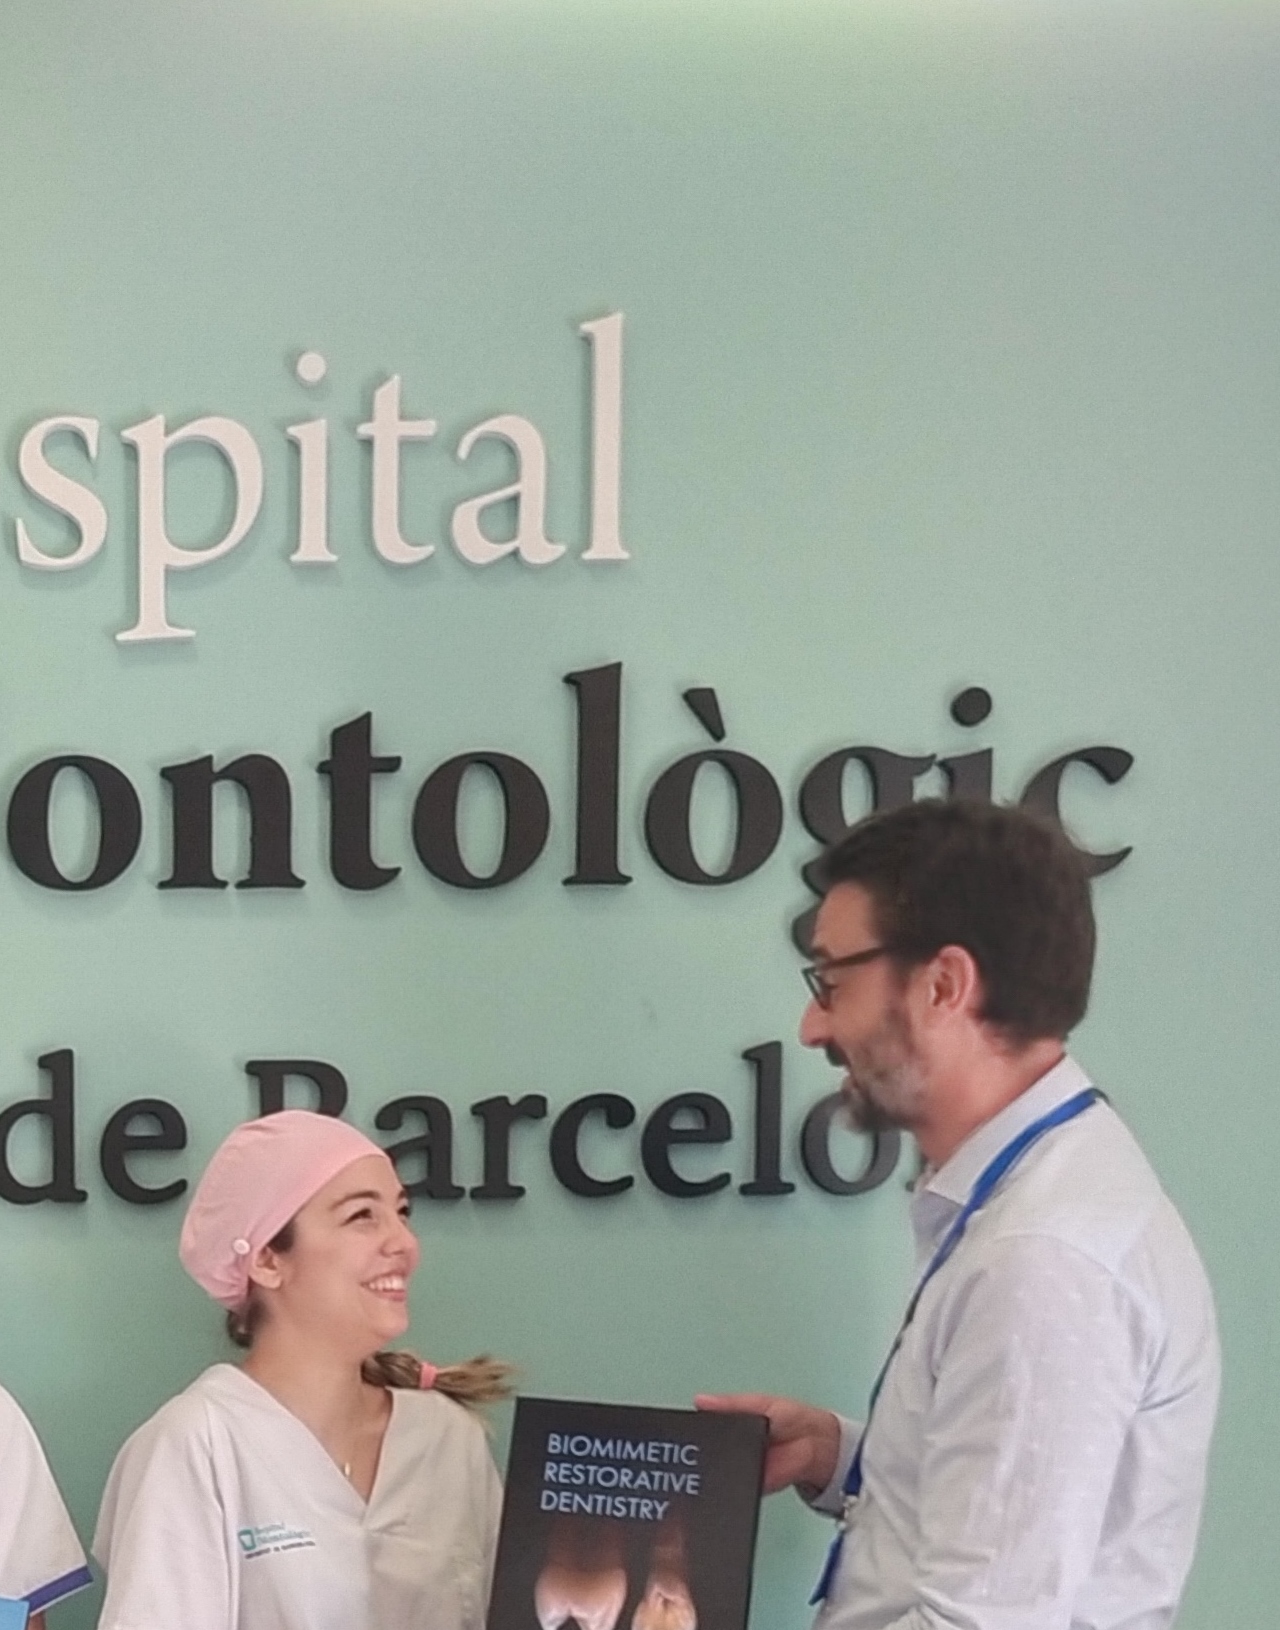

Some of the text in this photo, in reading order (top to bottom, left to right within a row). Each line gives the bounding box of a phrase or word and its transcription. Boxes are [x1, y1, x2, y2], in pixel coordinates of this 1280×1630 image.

[244, 1039, 926, 1200] arcelo
[547, 1432, 700, 1467] BIOMIMETIC
[543, 1461, 701, 1496] RESTORATIVE
[539, 1489, 670, 1520] DENTISTRY
